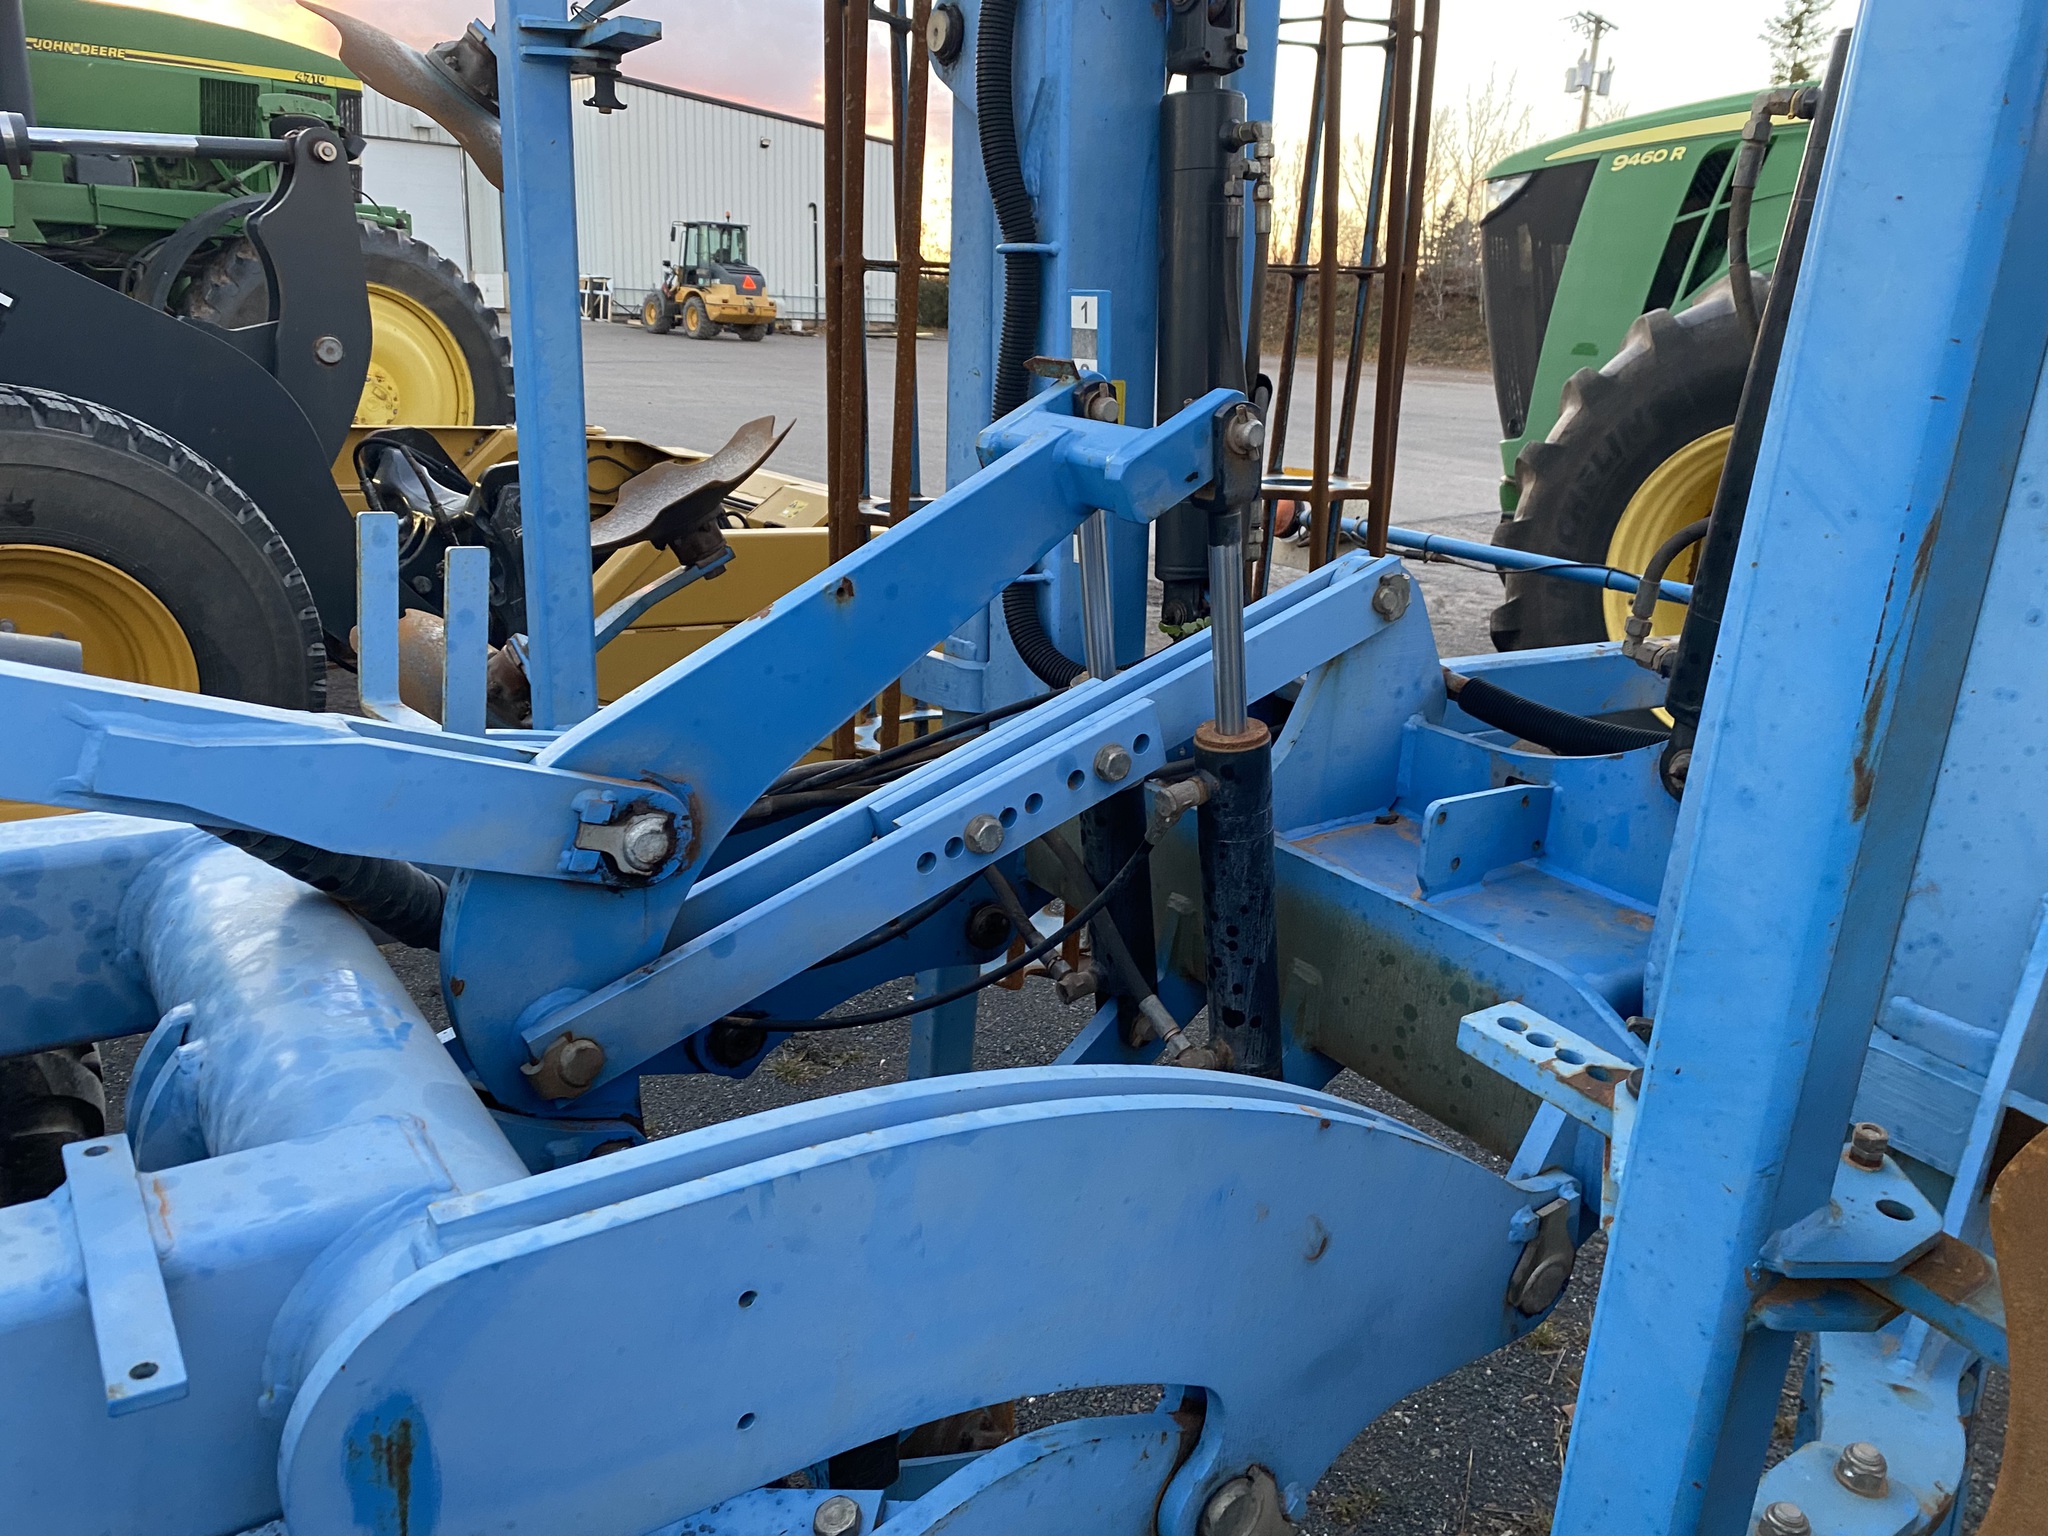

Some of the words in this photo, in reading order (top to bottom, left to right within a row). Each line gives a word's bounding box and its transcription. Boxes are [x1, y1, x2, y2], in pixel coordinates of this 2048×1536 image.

[33, 39, 74, 52] JOHN
[80, 44, 125, 58] DEERE
[295, 71, 326, 84] 4710
[1611, 149, 1668, 171] 9460
[1669, 146, 1687, 162] R
[1080, 300, 1088, 324] 1
